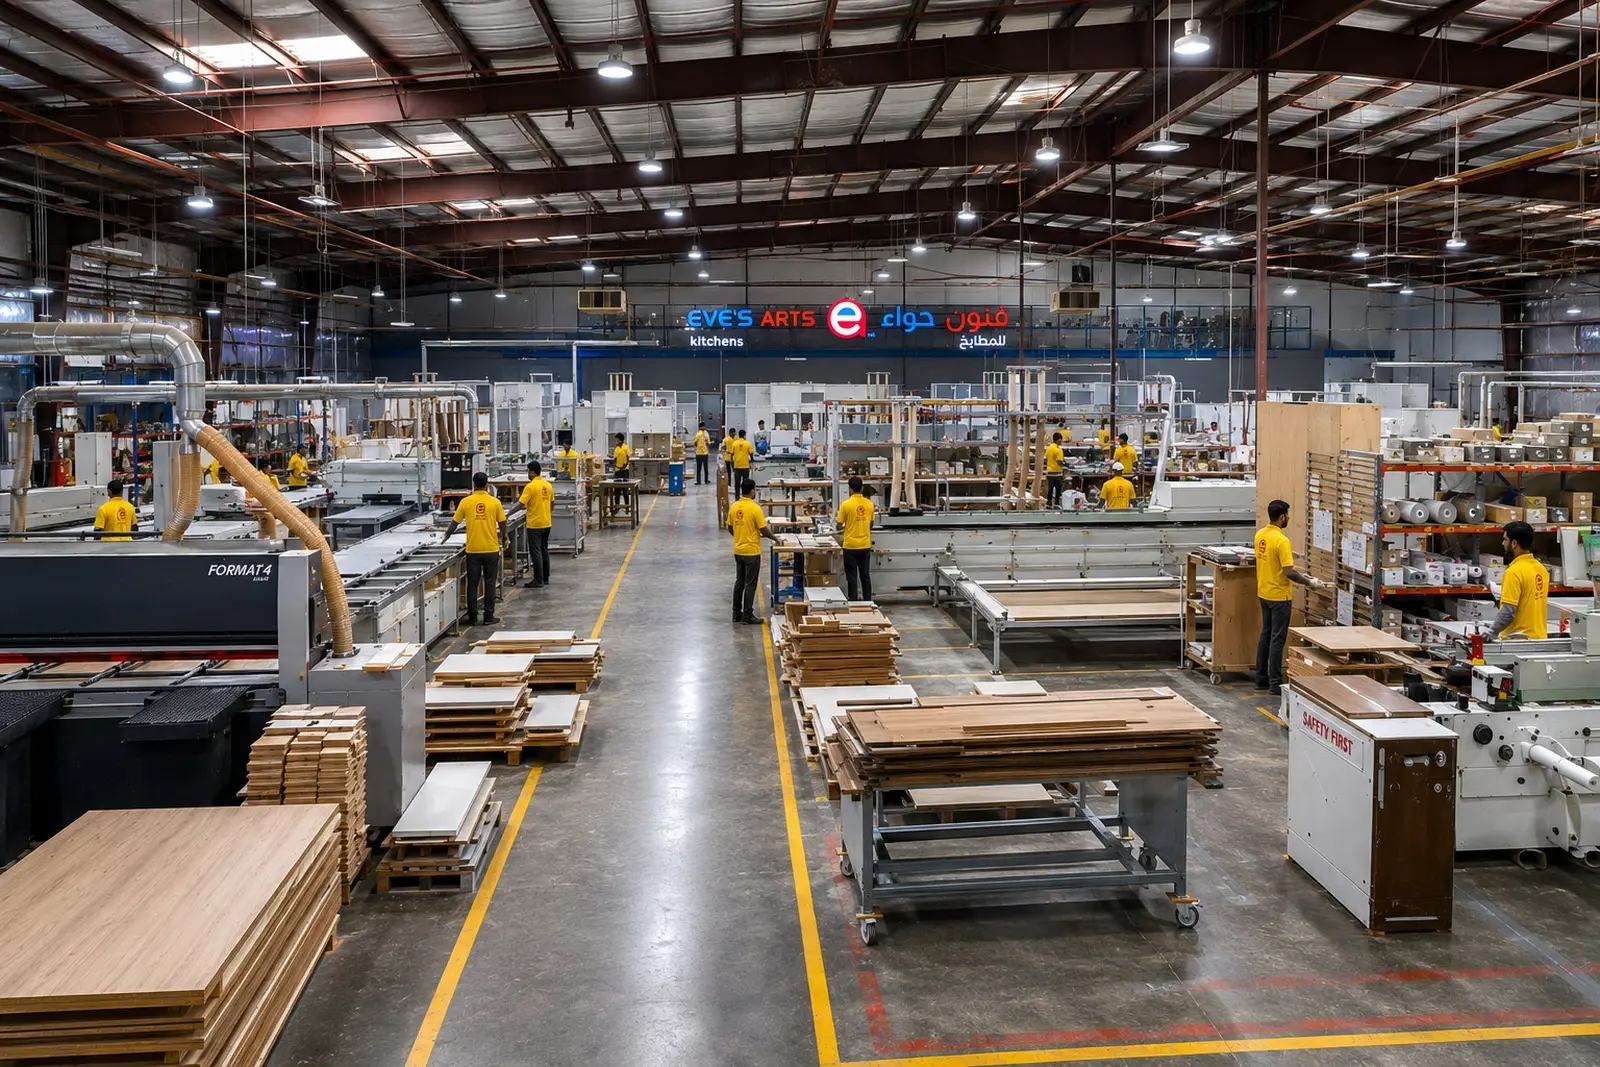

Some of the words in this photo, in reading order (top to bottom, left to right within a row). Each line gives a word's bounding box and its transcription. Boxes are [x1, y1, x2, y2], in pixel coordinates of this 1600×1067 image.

[687, 309, 753, 327] EVE'S
[761, 310, 816, 327] ARTS
[881, 305, 935, 333] حواء
[945, 305, 1008, 333] فنون
[690, 335, 744, 347] kitchens
[959, 334, 1006, 350] للمطابخ
[1302, 711, 1330, 740] SAFETY
[1331, 729, 1354, 756] FIRST
